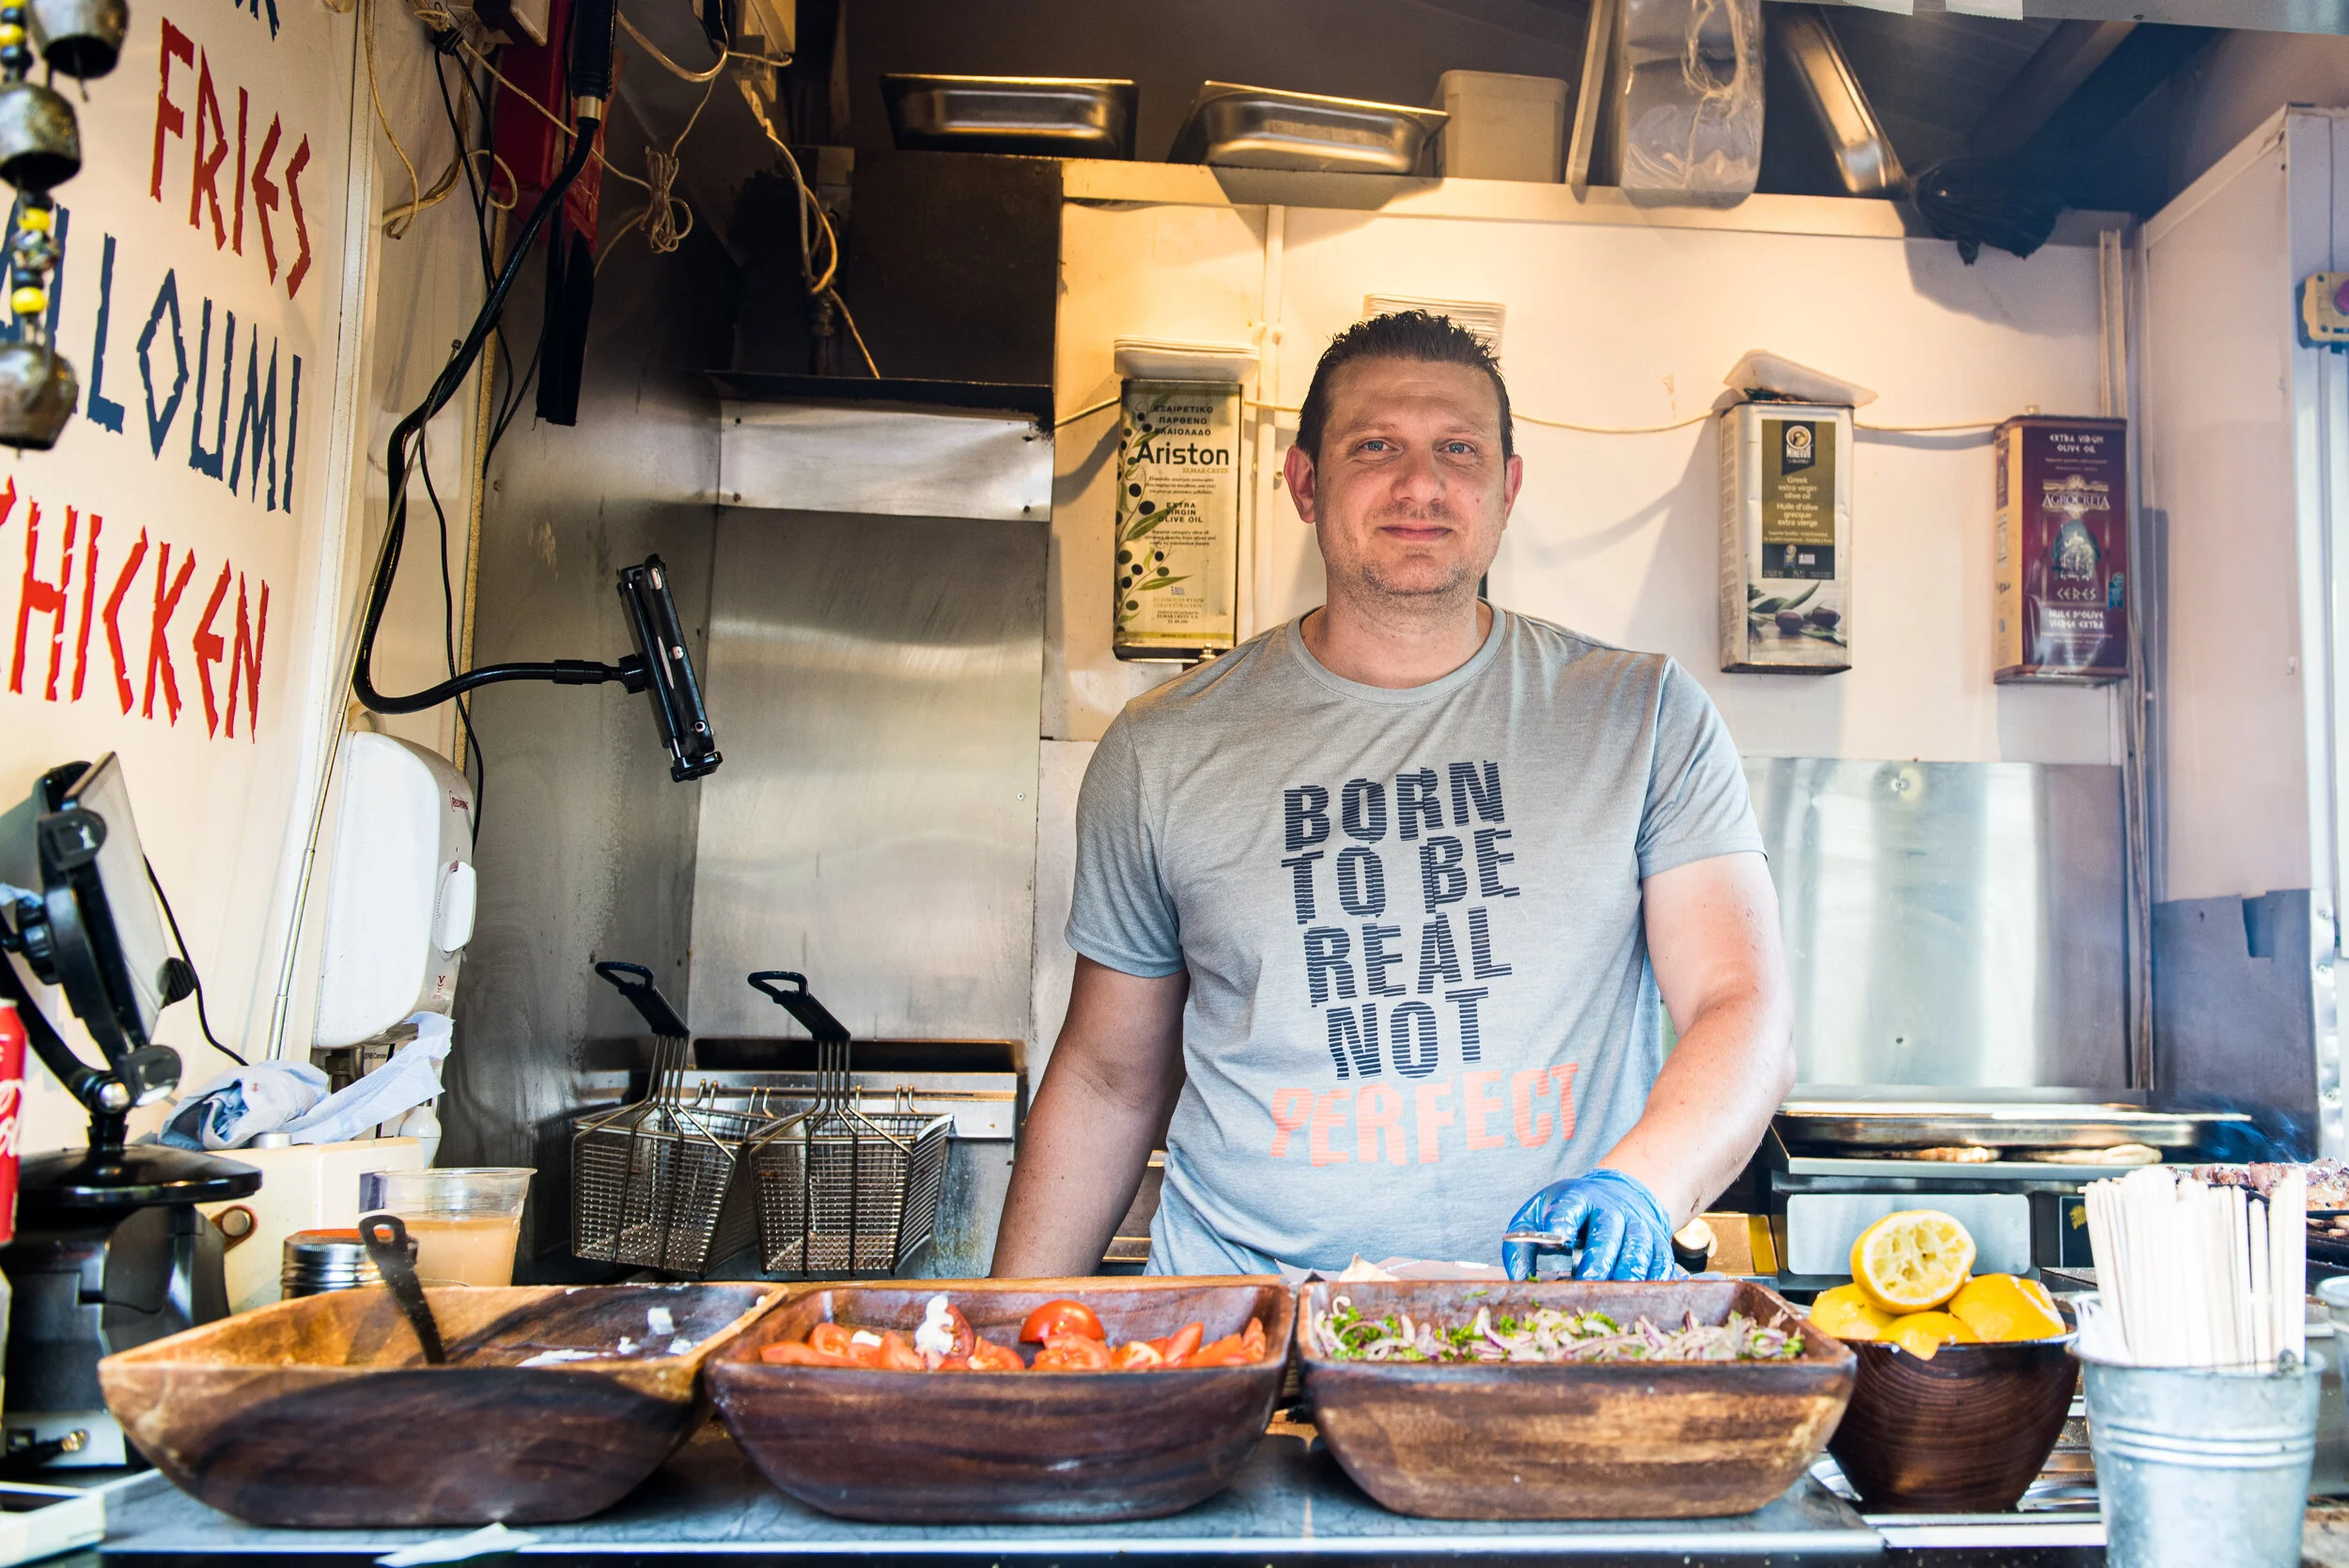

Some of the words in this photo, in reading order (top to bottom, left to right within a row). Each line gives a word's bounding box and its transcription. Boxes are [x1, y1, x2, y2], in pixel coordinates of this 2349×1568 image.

[150, 16, 312, 301] FRIES
[1159, 416, 1207, 425] ΠΑΡΘΕΝΟ
[2049, 433, 2076, 442] EXTRA
[2078, 435, 2104, 444] VIRGIN
[1136, 442, 1229, 465] Ariston
[2057, 443, 2080, 453] OLIVE
[2083, 445, 2096, 454] OIL
[1787, 475, 1808, 484] Greek
[1797, 484, 1817, 493] virgin
[1783, 512, 1812, 520] grecque
[1797, 520, 1819, 528] vierge
[2057, 587, 2097, 600] CERES
[2049, 618, 2076, 629] VIERGE
[2078, 619, 2105, 629] EXTRA
[1283, 760, 1504, 852] BORN
[1281, 846, 1387, 925] TO
[1419, 828, 1520, 914] BE
[1303, 906, 1513, 1007] REAL
[1326, 986, 1489, 1080] NOT
[1269, 1062, 1579, 1167] PERFECT
